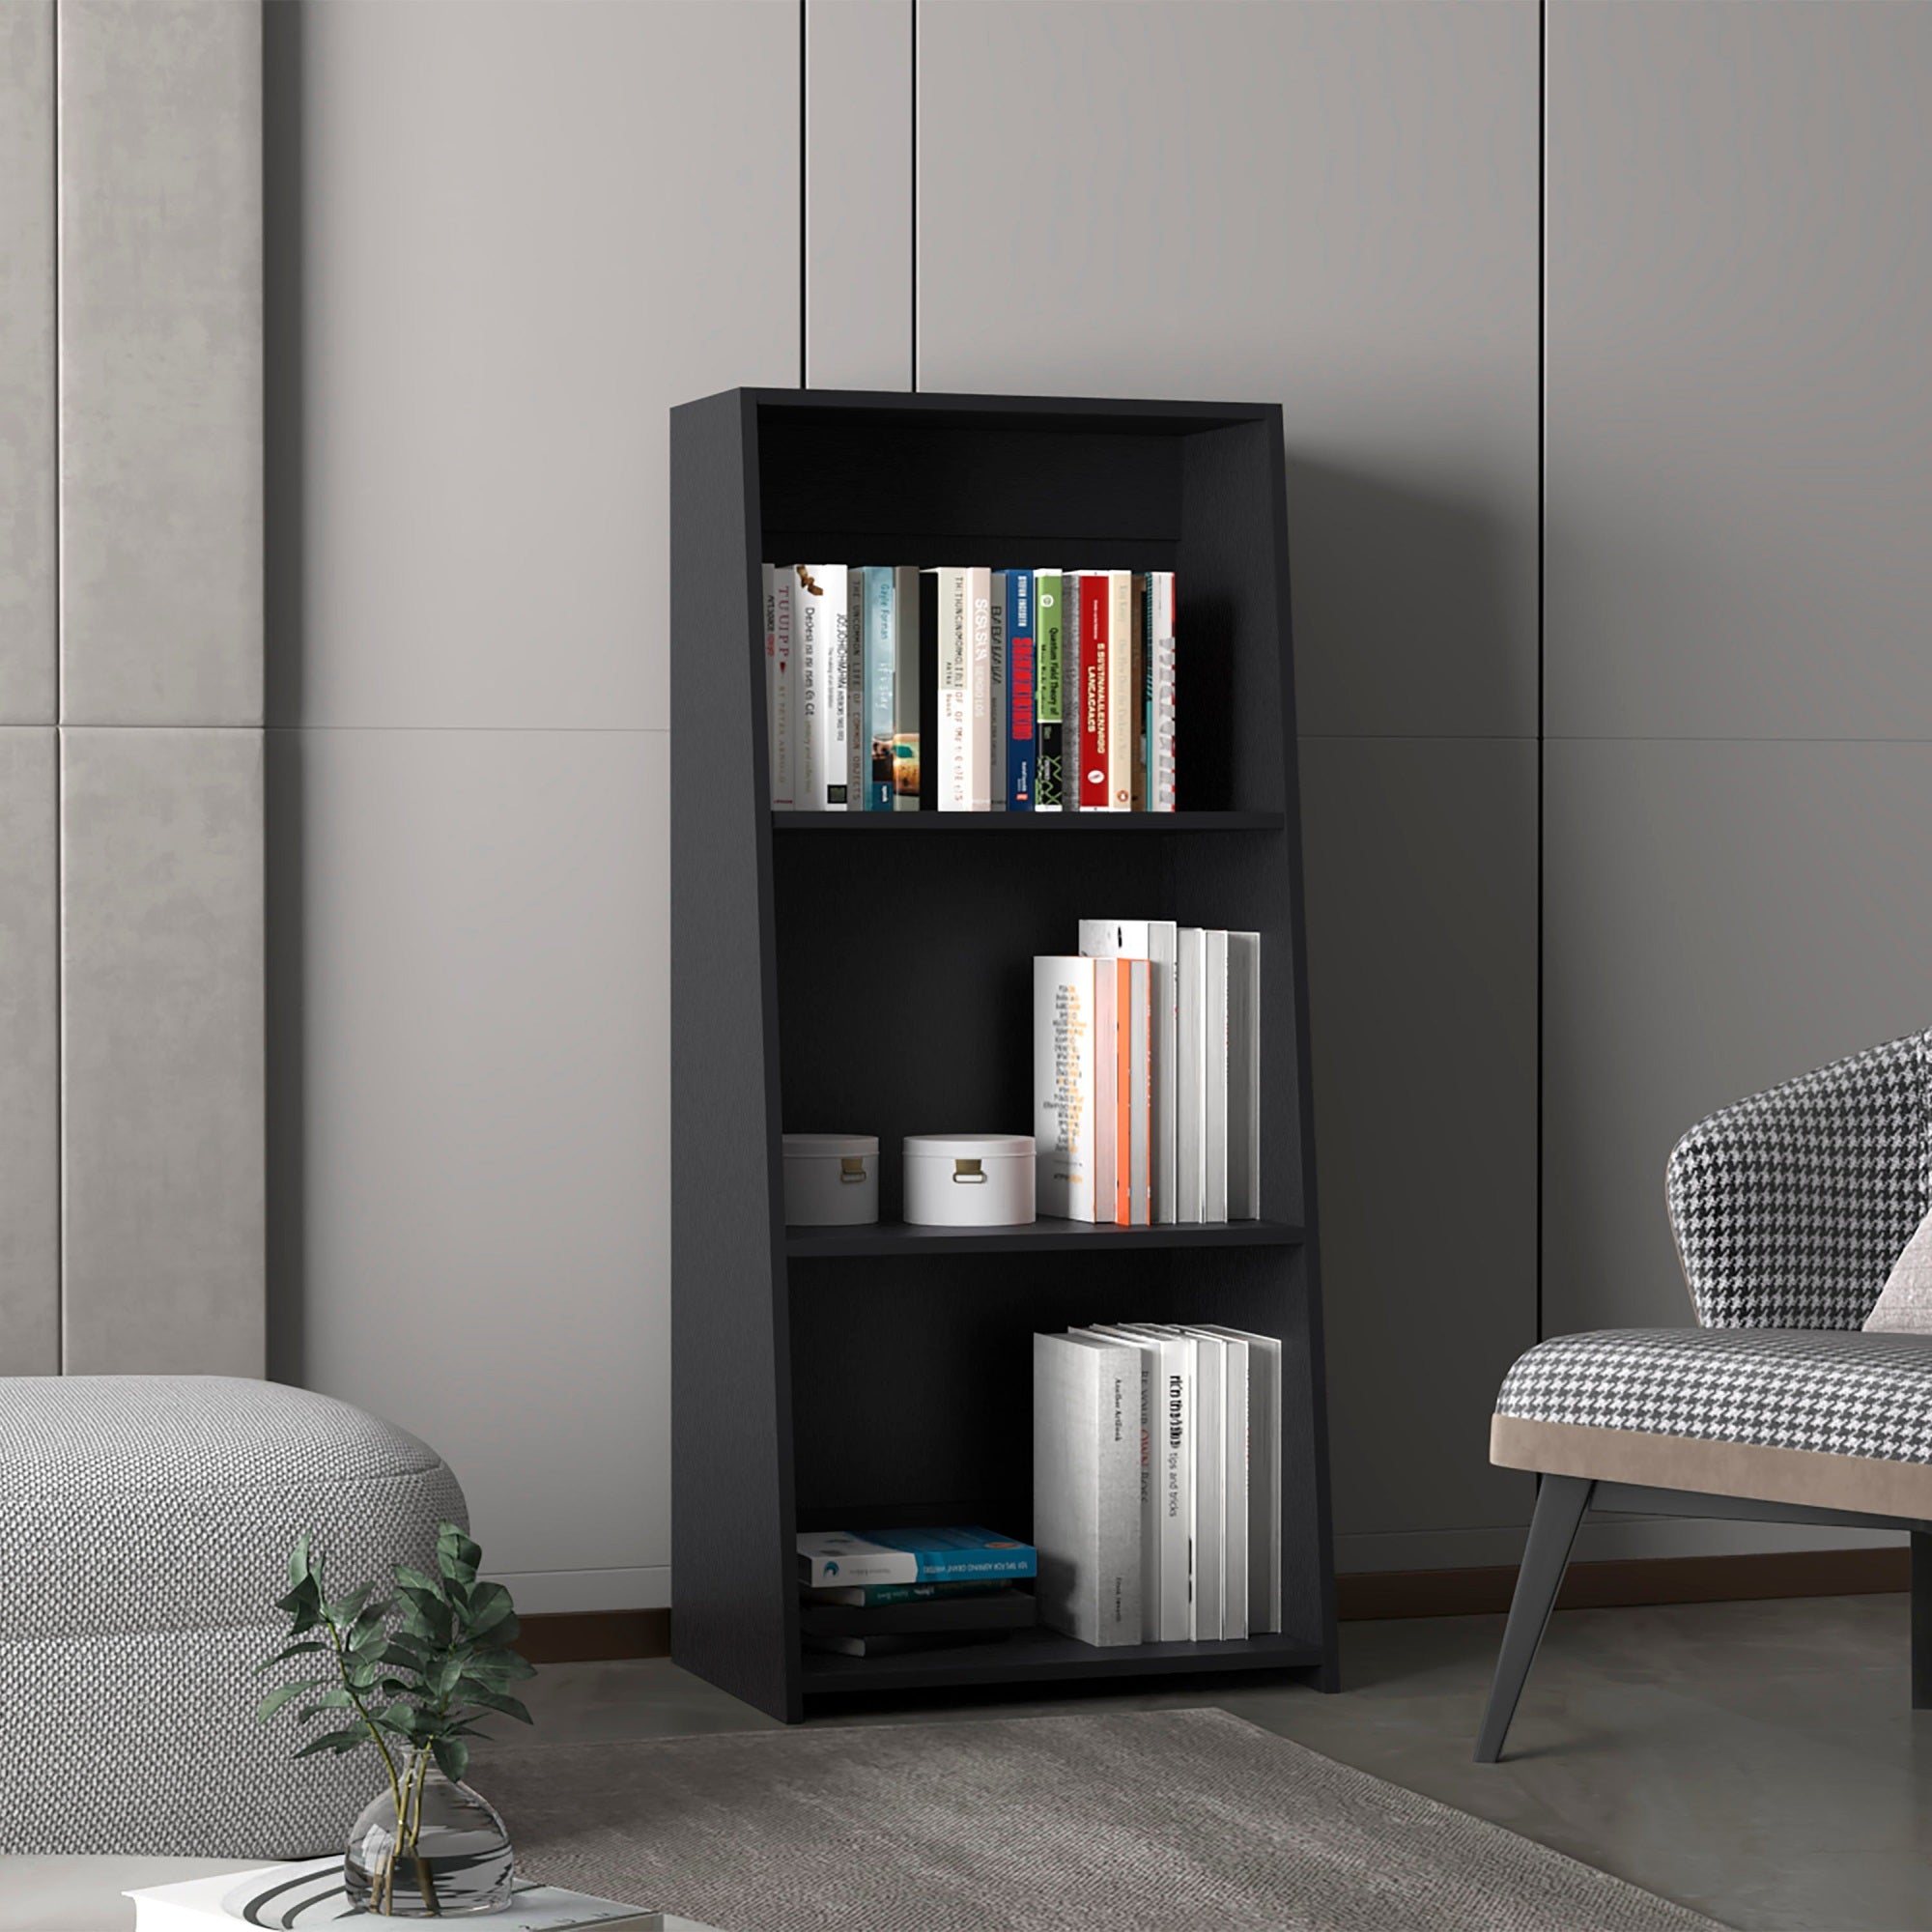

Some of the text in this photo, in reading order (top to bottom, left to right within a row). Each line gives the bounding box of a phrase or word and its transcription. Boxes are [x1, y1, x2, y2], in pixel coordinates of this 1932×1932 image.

[879, 583, 890, 607] Gayle
[880, 609, 890, 639] Forman
[1049, 627, 1059, 660] Quantum
[1050, 663, 1059, 680] Field
[1048, 681, 1059, 705] Theory
[852, 755, 861, 801] OBJECTS
[1168, 1452, 1178, 1470] tips
[1169, 1472, 1179, 1490] and
[1169, 1492, 1178, 1518] tricks
